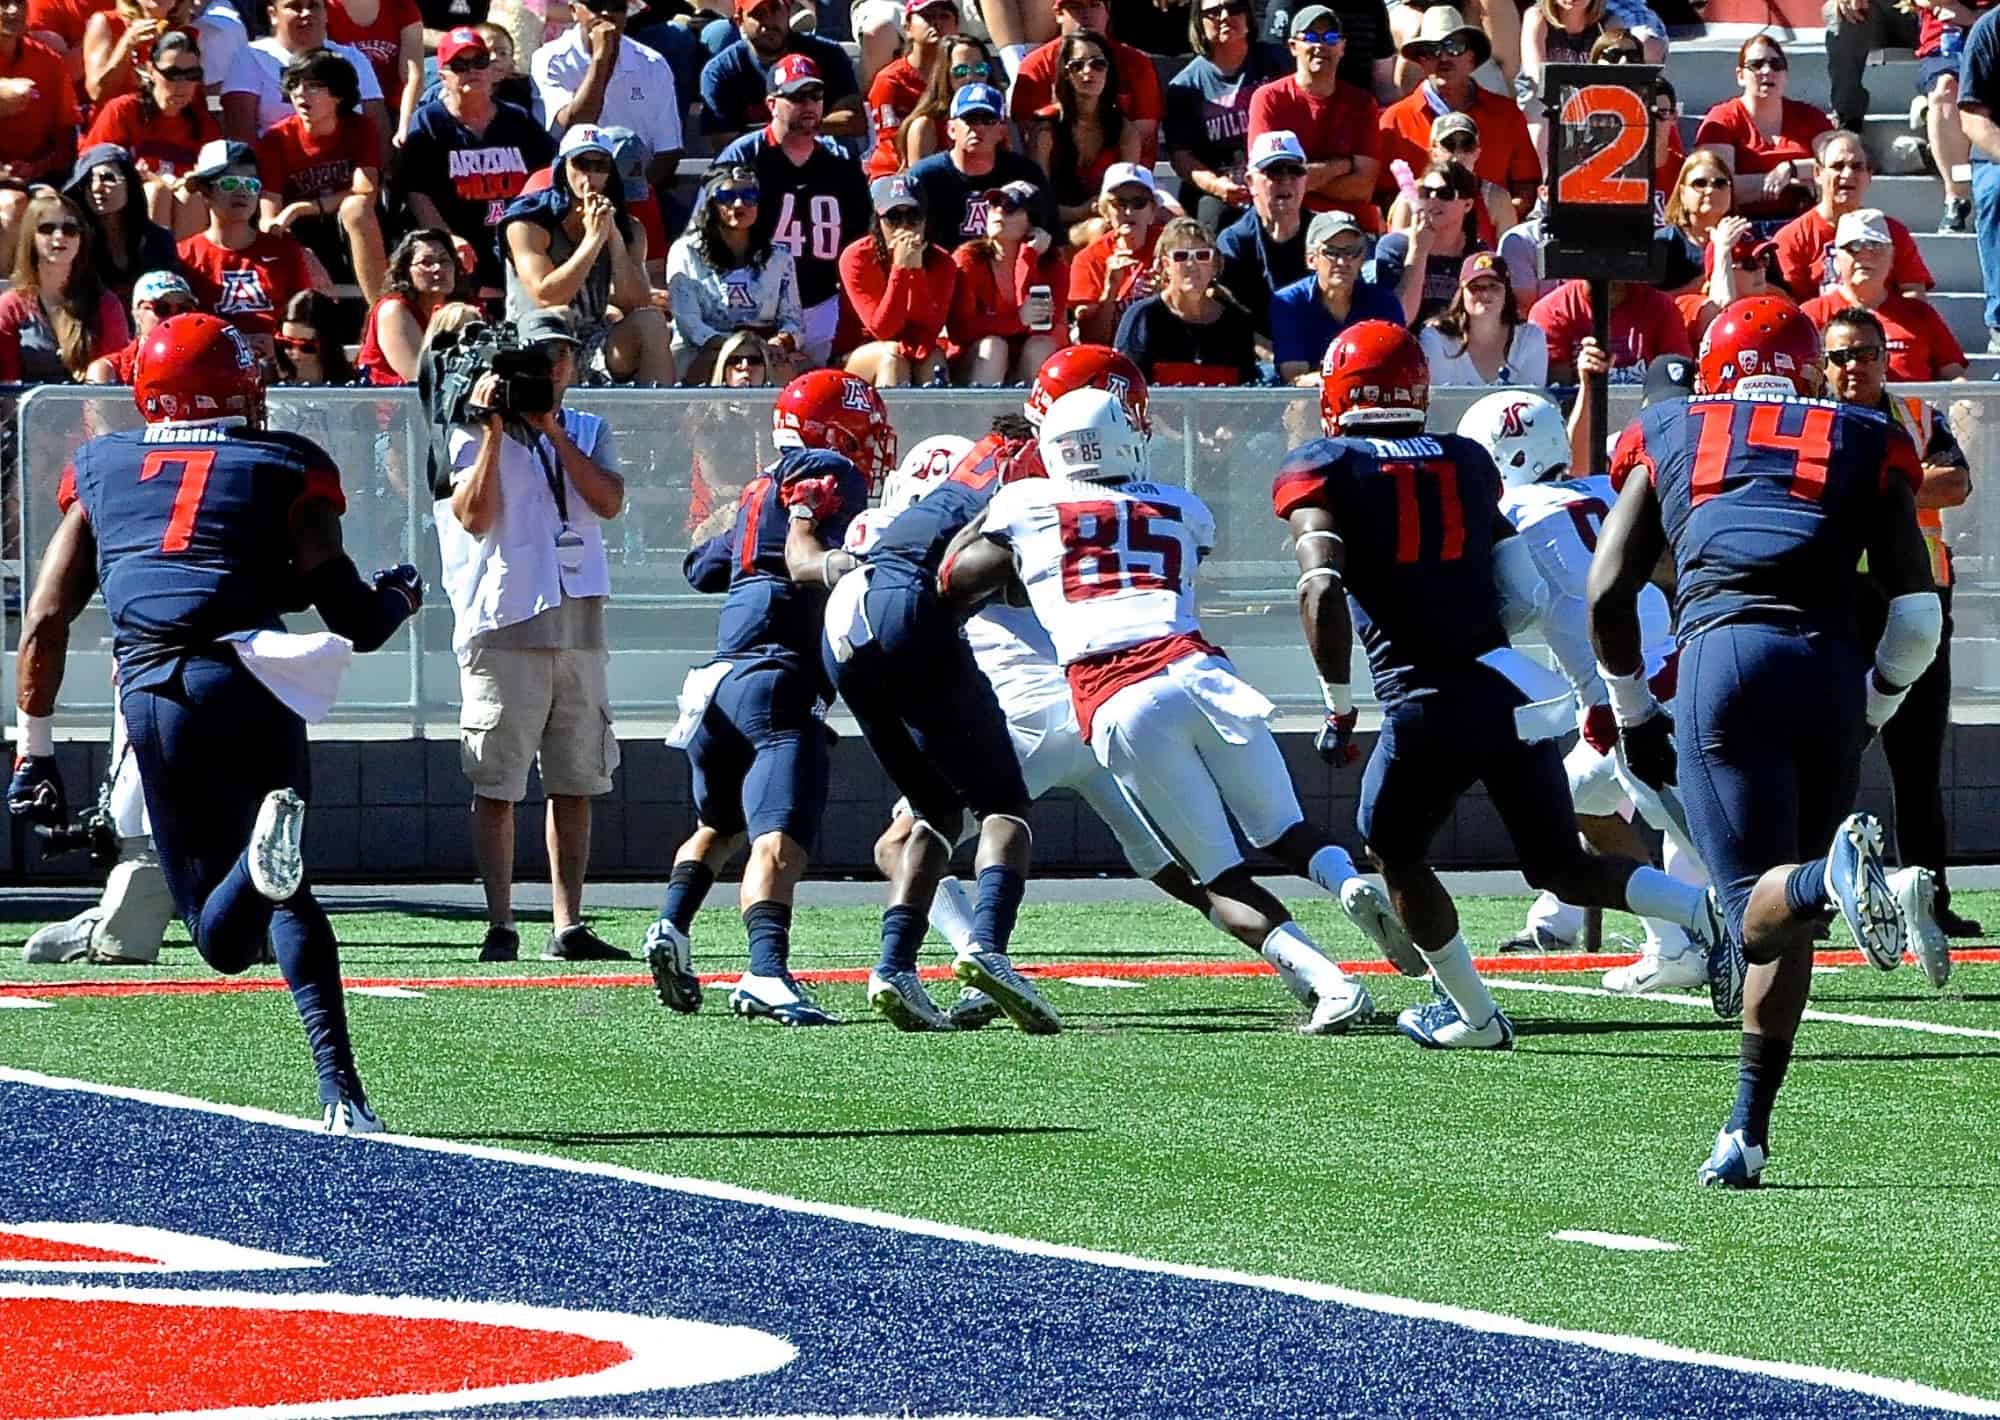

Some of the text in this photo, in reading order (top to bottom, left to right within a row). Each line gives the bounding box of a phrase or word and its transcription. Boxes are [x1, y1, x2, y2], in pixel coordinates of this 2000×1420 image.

[449, 147, 528, 178] ARIZONA
[1558, 84, 1650, 204] 2
[772, 193, 842, 260] 48
[137, 449, 218, 554] 7
[1081, 442, 1103, 462] 85
[1689, 402, 1836, 509] 14
[1056, 499, 1184, 604] 85
[1379, 460, 1466, 565] 11
